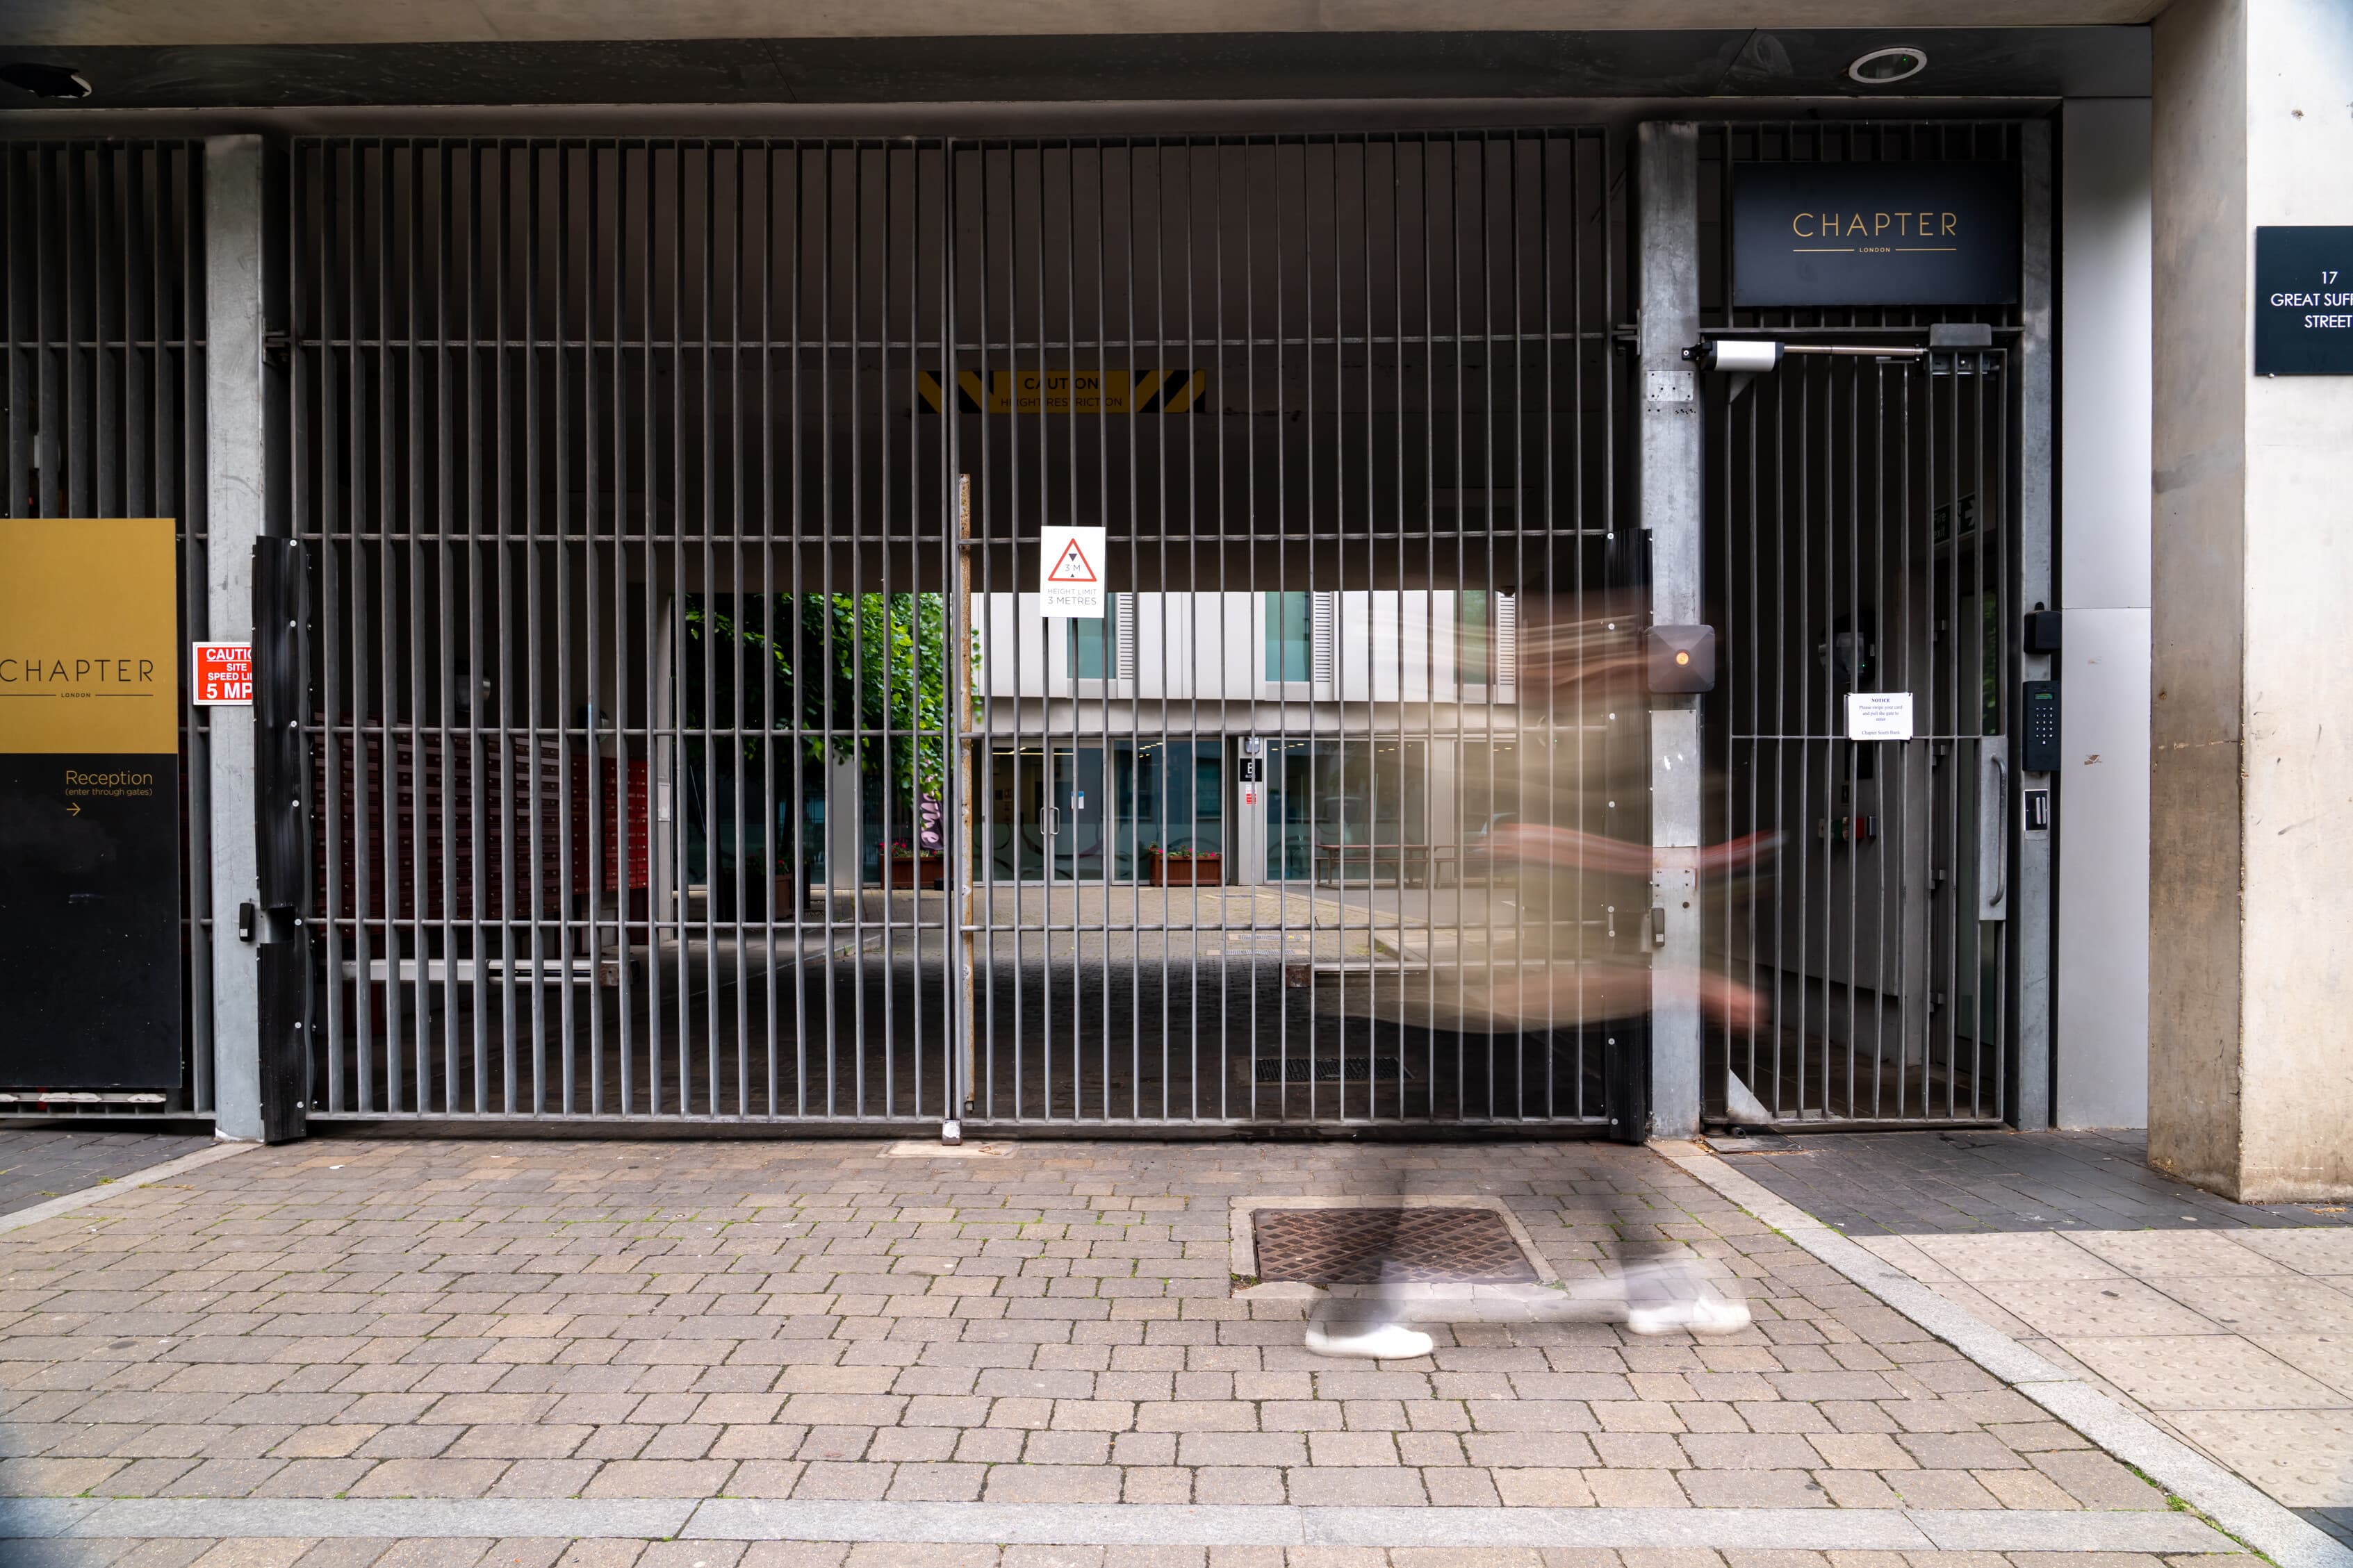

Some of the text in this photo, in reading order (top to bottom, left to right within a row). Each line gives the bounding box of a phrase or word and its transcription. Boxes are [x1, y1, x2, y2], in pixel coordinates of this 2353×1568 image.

[1792, 213, 1957, 238] CHAPTER
[2322, 271, 2338, 284] 17
[2270, 293, 2321, 306] GREAT
[2304, 315, 2353, 328] STREET
[1048, 596, 1097, 605] 3 METRES
[0, 659, 154, 682] CHAPTER
[226, 663, 247, 671] SITE
[207, 672, 252, 681] SPEED LI
[206, 683, 218, 699] 5
[66, 770, 153, 788] Reception
[65, 789, 153, 798] (enter through gates)
